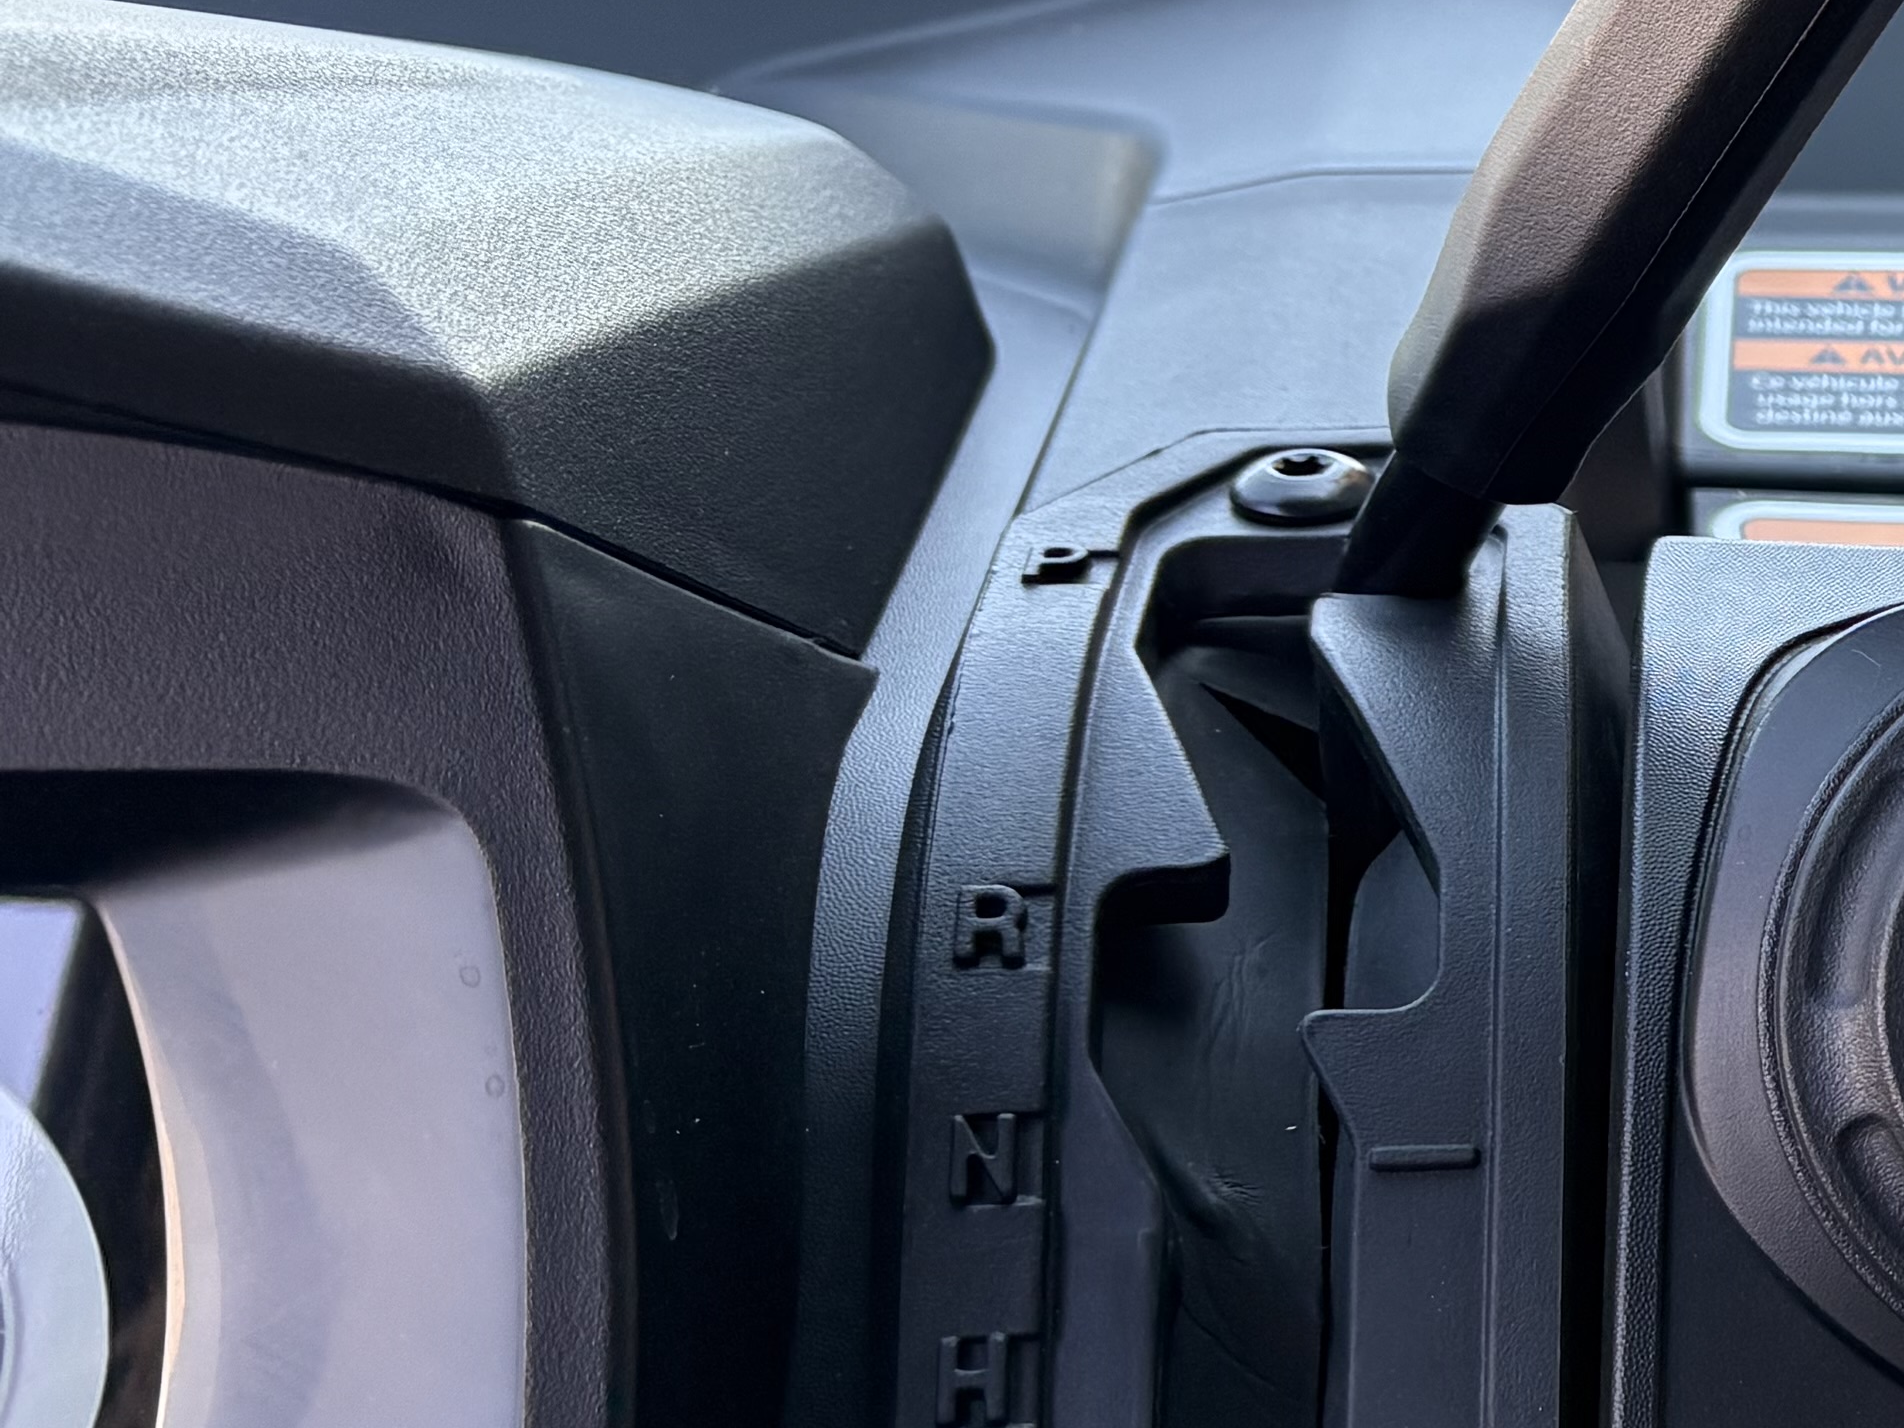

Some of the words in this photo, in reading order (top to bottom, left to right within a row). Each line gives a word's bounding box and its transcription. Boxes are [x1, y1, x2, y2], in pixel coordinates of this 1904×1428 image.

[1021, 544, 1090, 583] P
[954, 883, 1028, 970] R
[947, 1112, 1018, 1205] N
